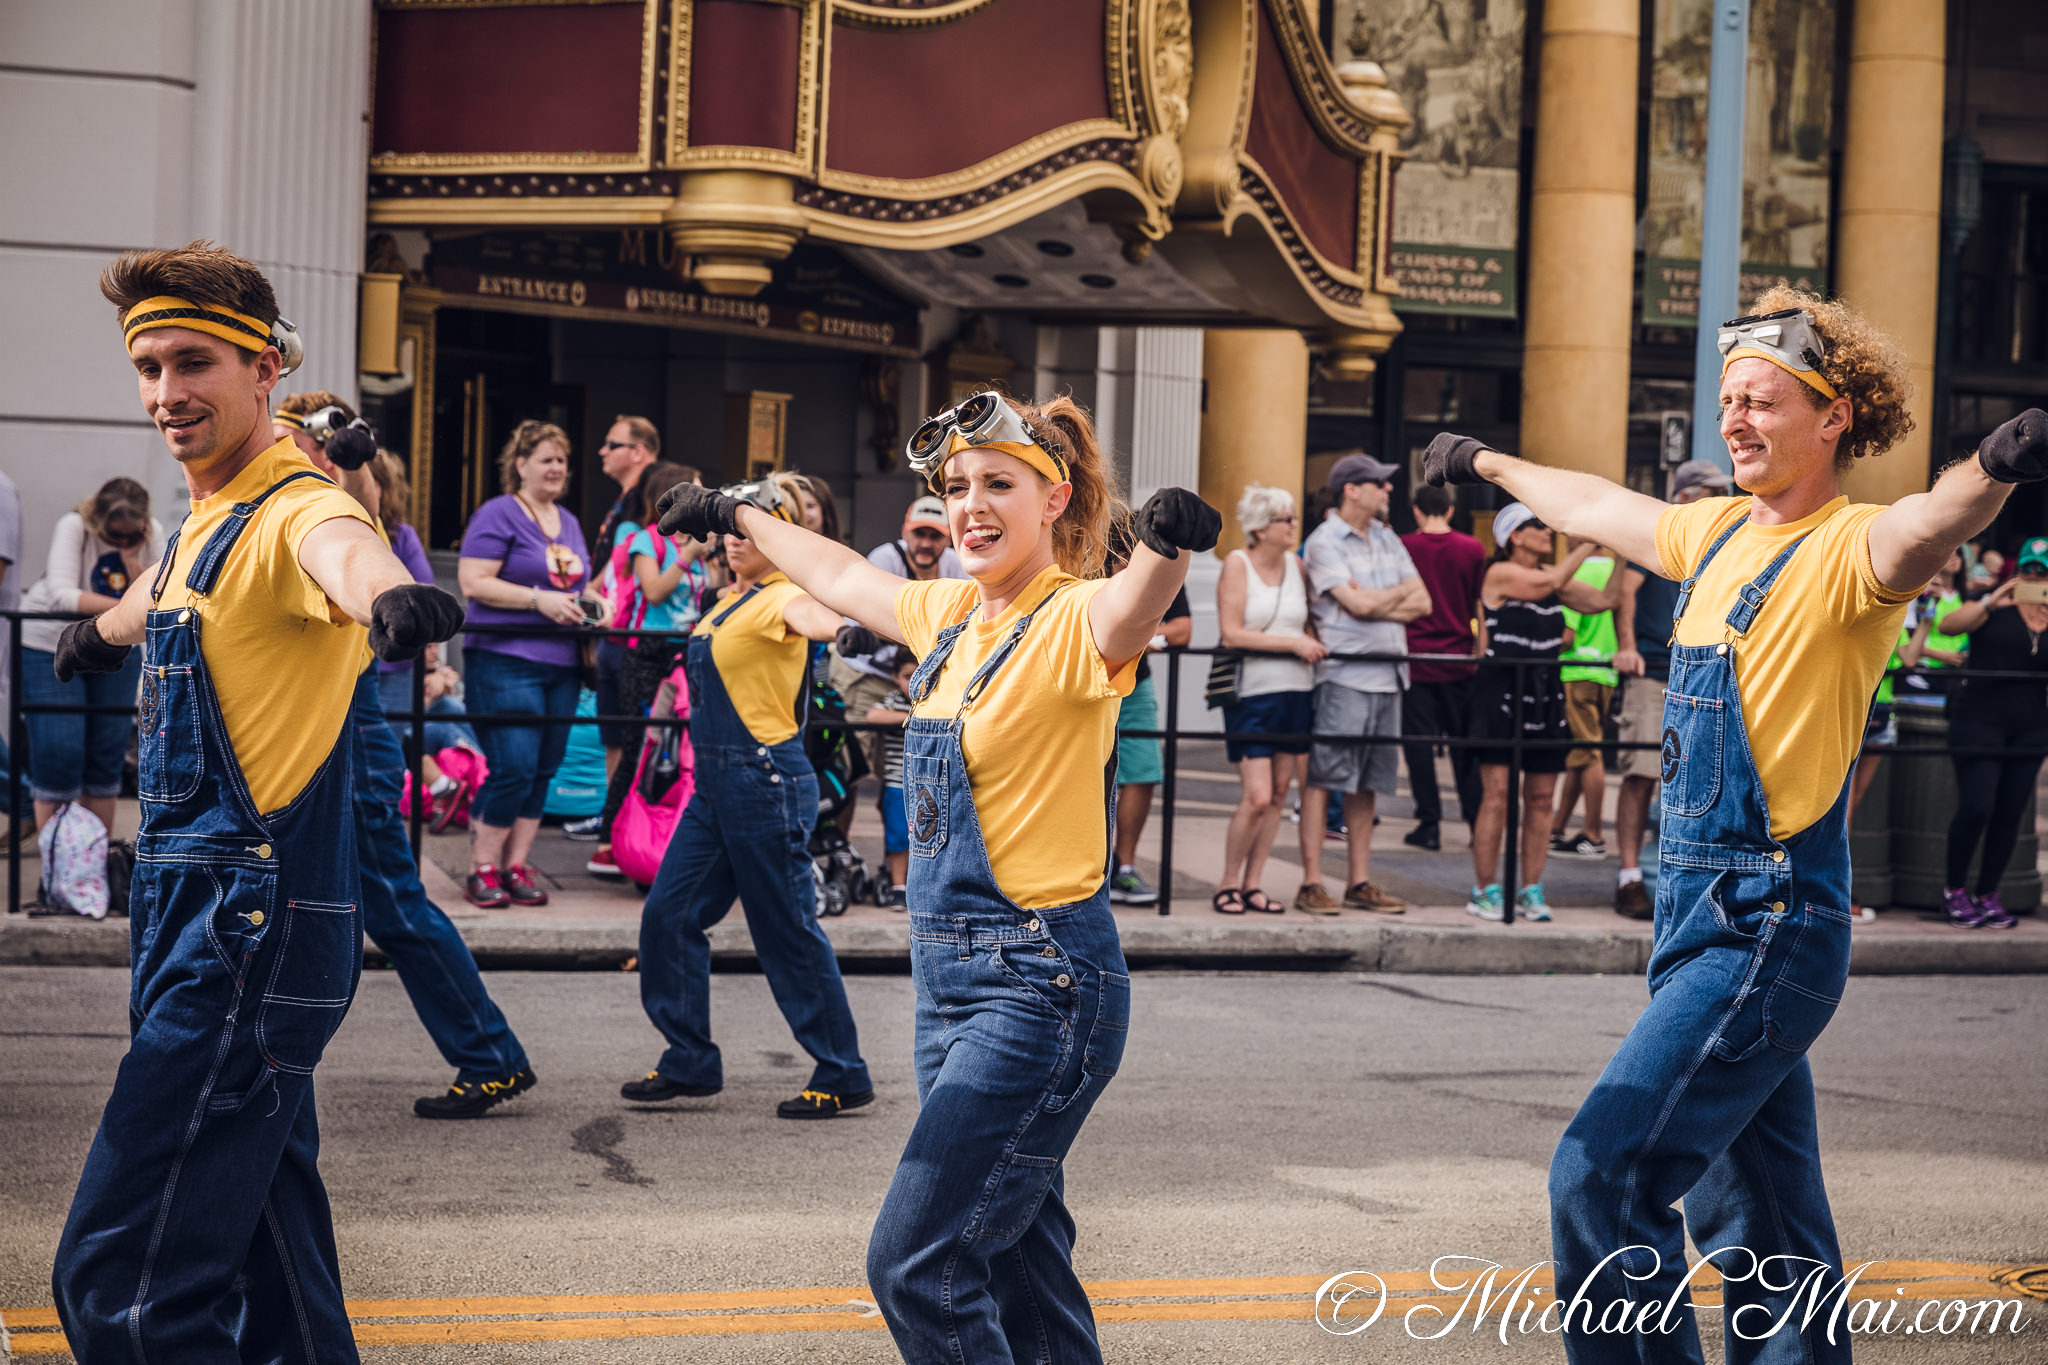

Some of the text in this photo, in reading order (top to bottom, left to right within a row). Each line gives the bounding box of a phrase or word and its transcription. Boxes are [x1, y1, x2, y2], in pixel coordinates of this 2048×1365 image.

[1391, 252, 1478, 273] CURSES
[478, 274, 569, 303] ENTRANCE
[1393, 269, 1490, 288] ENDS OF
[640, 288, 758, 320] SINGLE RIDERS
[1399, 285, 1503, 305] HARAOHS
[821, 317, 882, 340] EXPRESS
